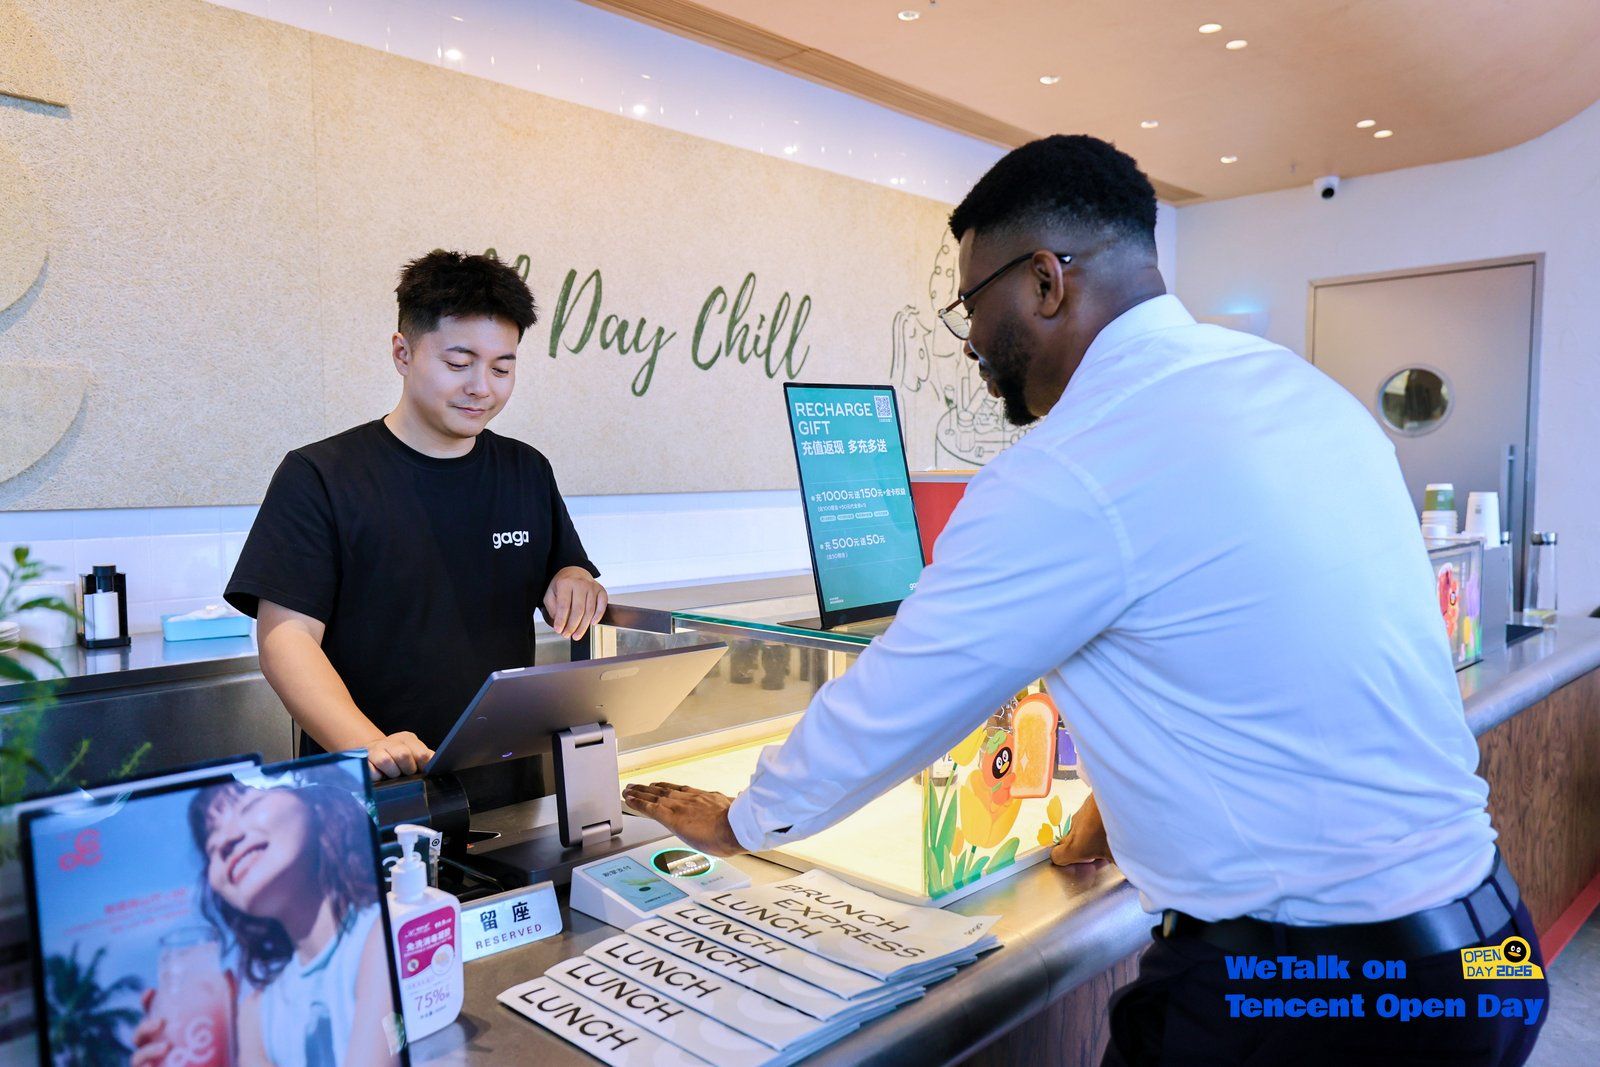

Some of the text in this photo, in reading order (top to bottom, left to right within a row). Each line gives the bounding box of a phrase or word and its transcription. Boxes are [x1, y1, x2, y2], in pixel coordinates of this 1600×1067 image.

[549, 269, 811, 397] Day Chill
[795, 403, 873, 417] RECHARGE
[798, 421, 830, 435] GIFT
[801, 438, 888, 456] 充值返现 多充多送
[492, 531, 529, 549] gaga
[480, 902, 531, 932] 留座
[675, 908, 787, 954] LUNCH
[710, 893, 823, 939] LUNCH
[773, 898, 926, 959] EXPRESS
[775, 884, 910, 933] BRUNCH
[476, 924, 543, 950] RESERVED
[646, 924, 761, 973] LUNCH
[566, 963, 684, 1023] LUNCH
[605, 943, 722, 999] LUNCH
[519, 987, 639, 1050] LUNCH
